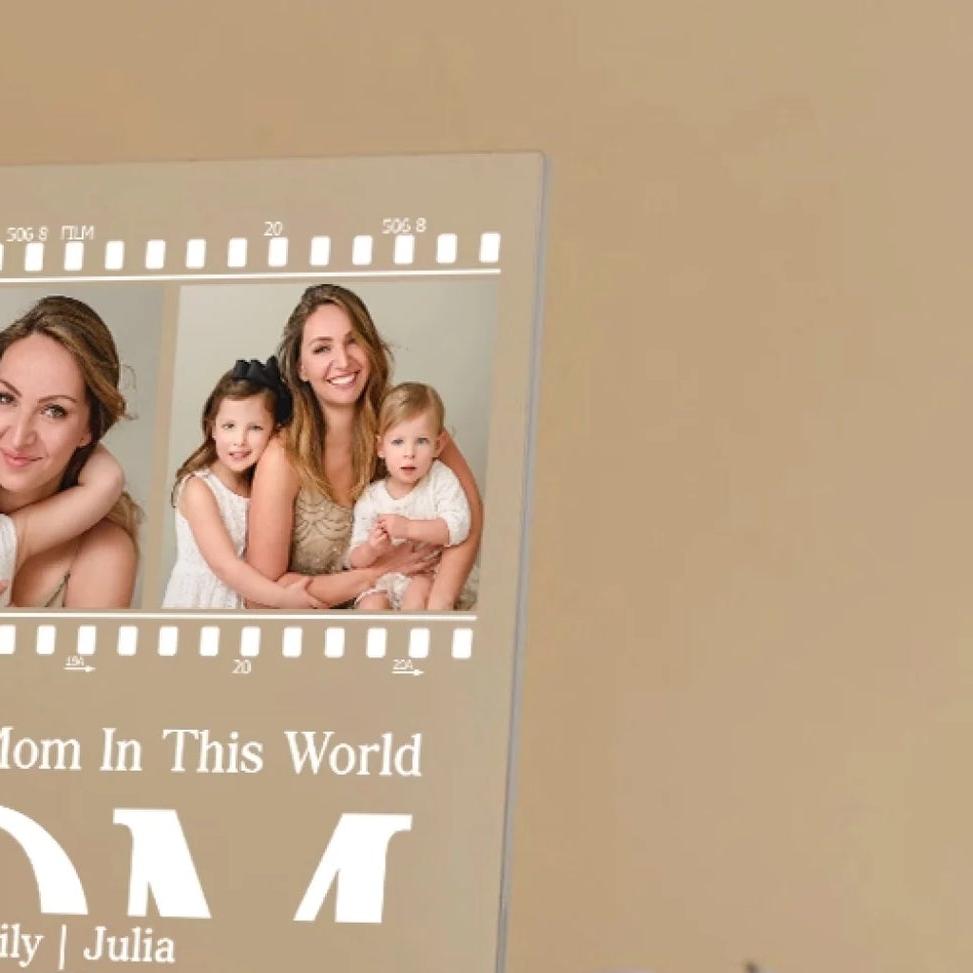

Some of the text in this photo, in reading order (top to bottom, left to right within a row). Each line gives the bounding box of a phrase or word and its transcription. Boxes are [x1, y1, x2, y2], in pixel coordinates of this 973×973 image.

[263, 221, 283, 236] 20
[231, 659, 252, 674] 20
[99, 727, 143, 772] In
[162, 729, 264, 774] This
[283, 730, 424, 777] World
[83, 925, 176, 963] Julia
